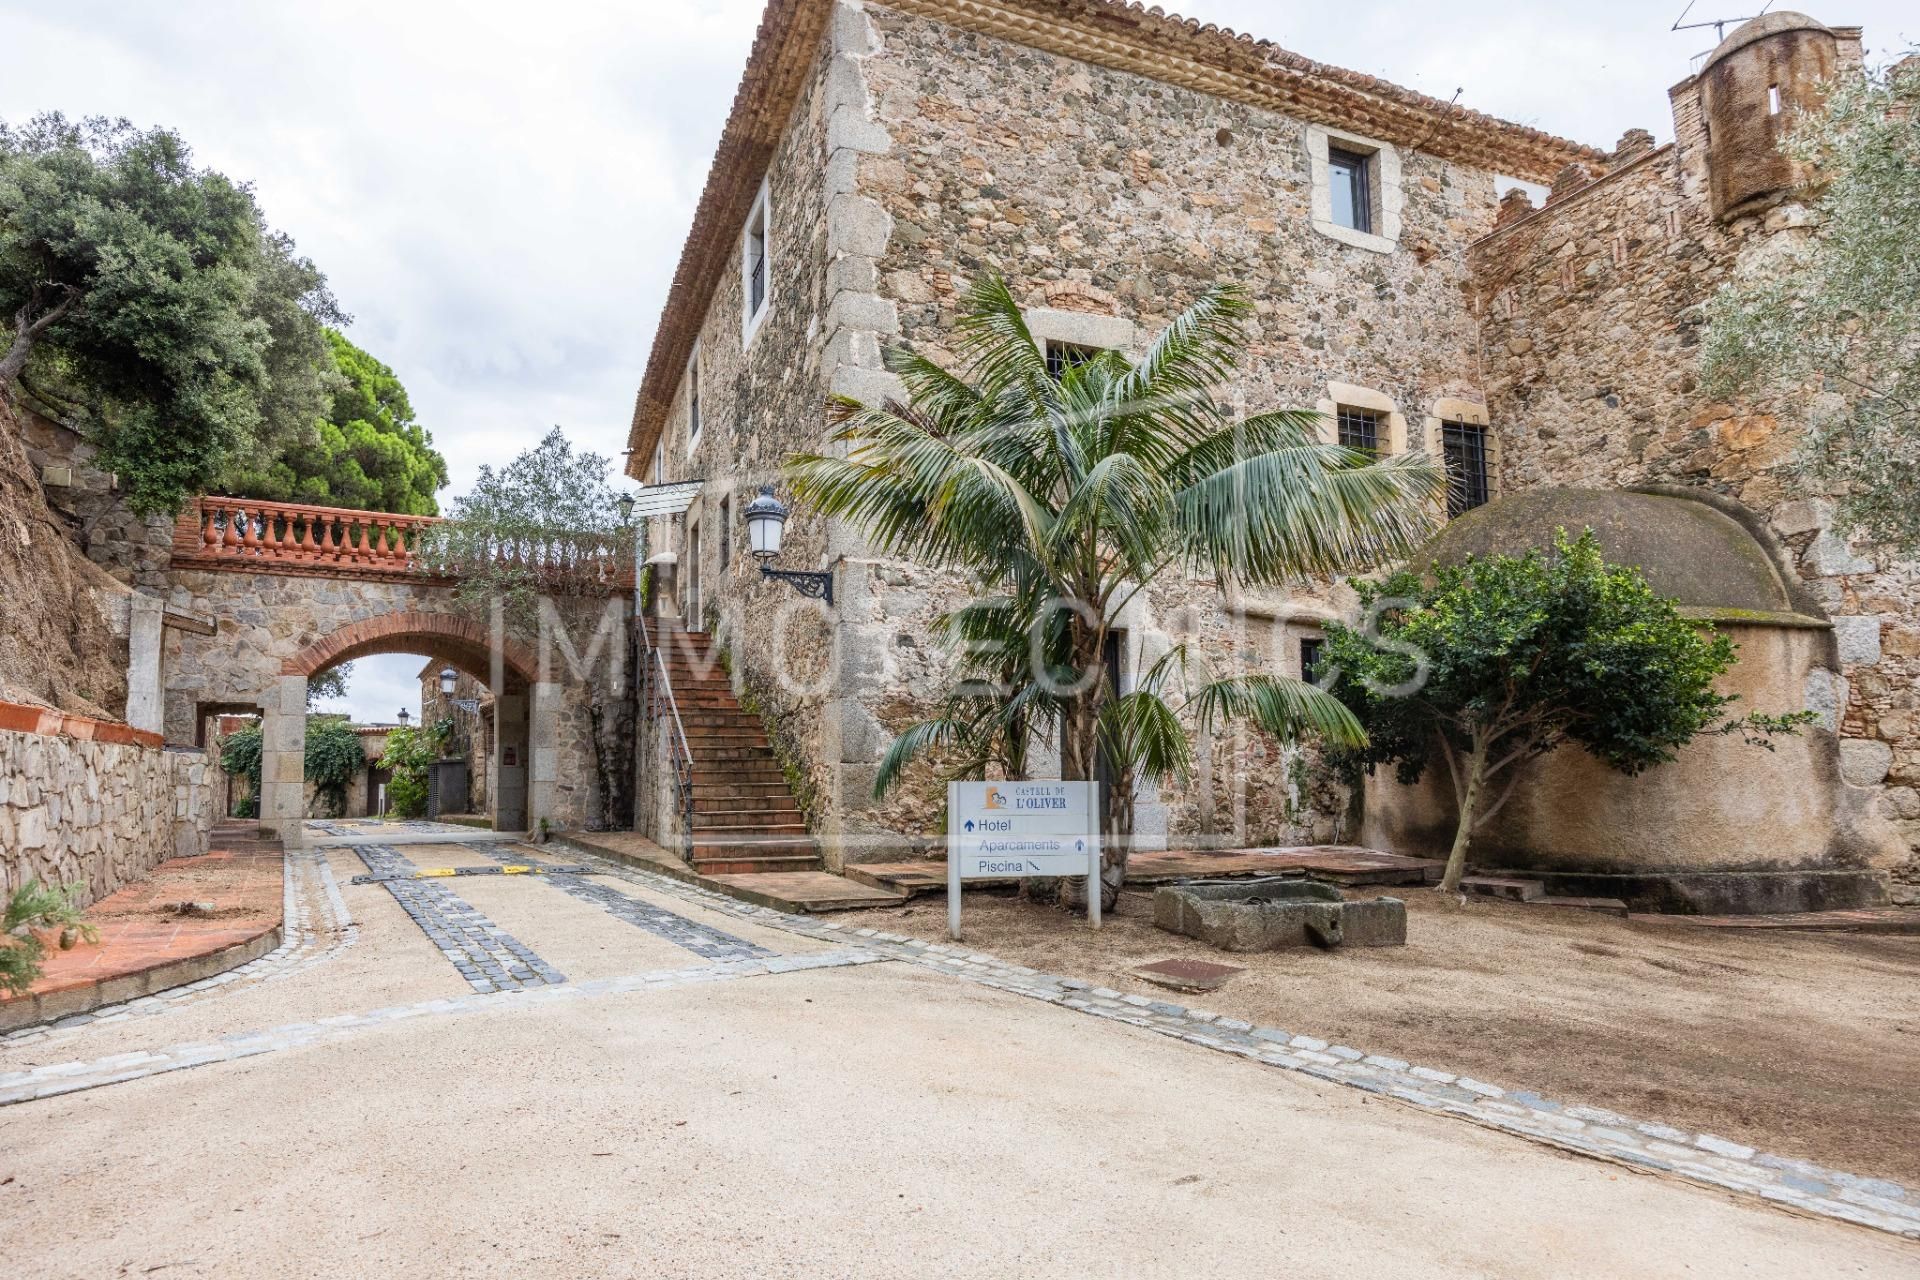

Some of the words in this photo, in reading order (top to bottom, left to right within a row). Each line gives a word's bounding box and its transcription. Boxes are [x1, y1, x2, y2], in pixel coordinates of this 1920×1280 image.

[1015, 786, 1051, 796] CASTELL
[1016, 797, 1067, 809] L'OLIVER
[978, 819, 1012, 832] Hotel
[979, 839, 1061, 853] Aparcaments
[978, 860, 1023, 873] Piscina
